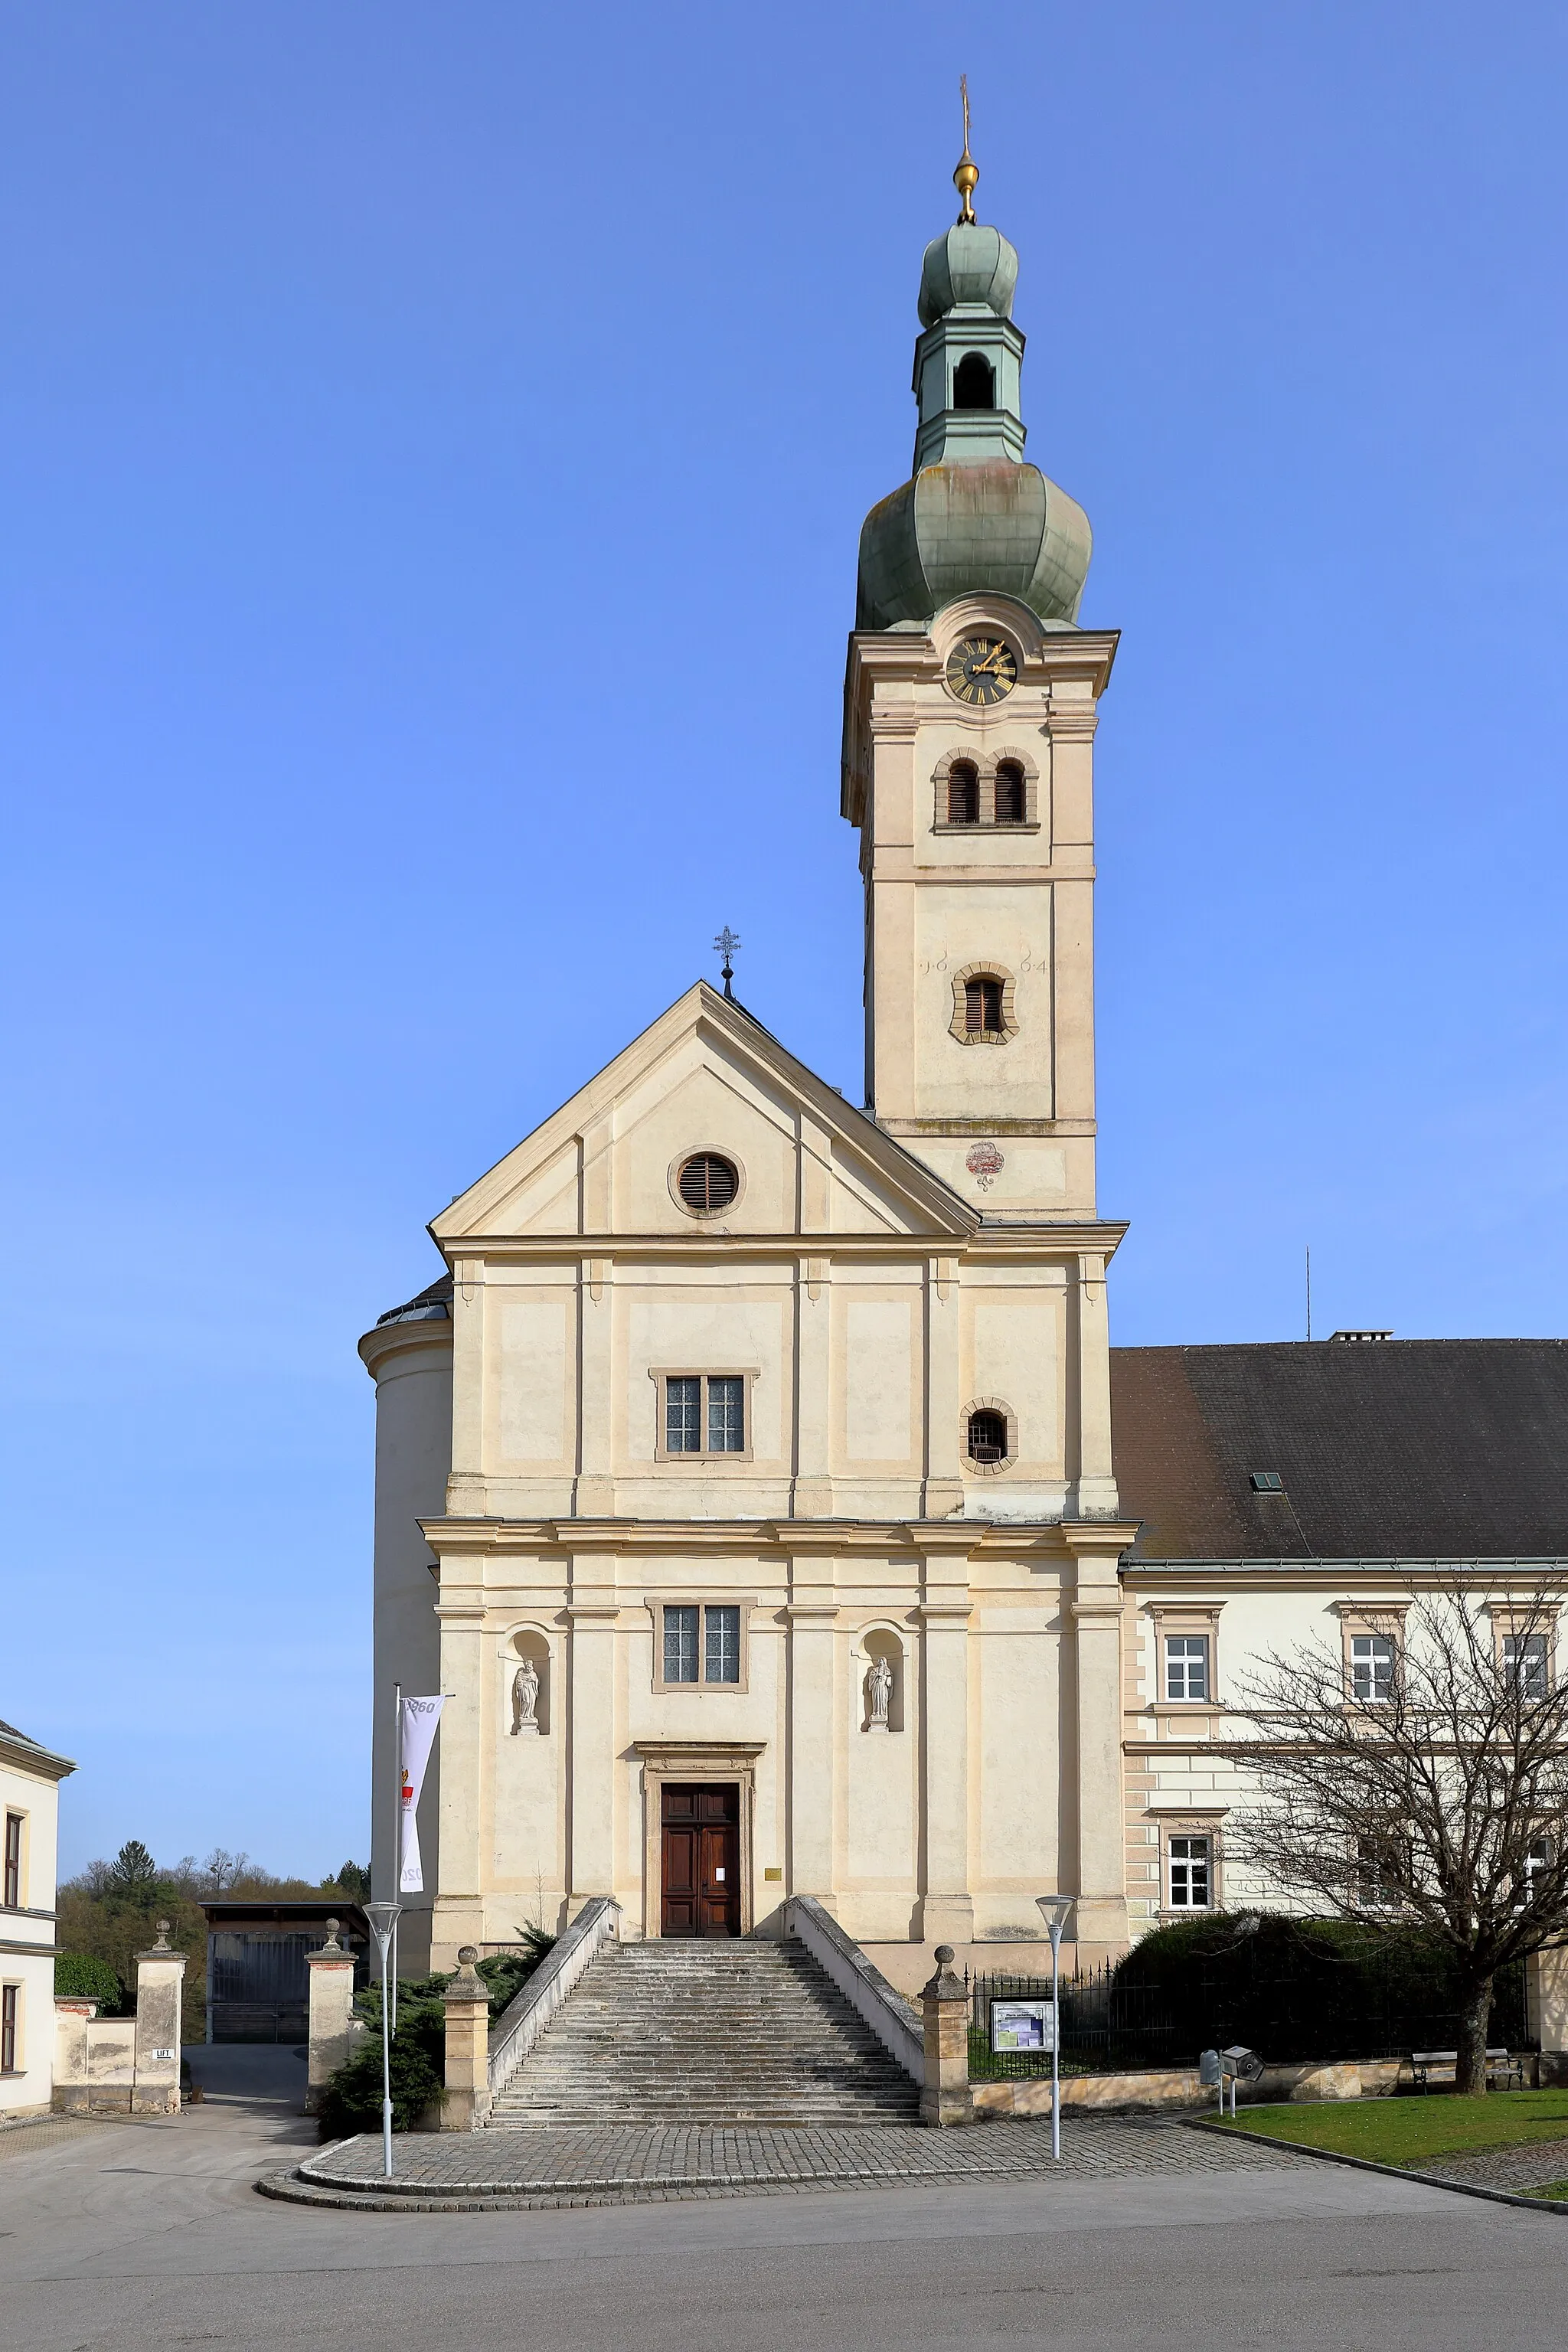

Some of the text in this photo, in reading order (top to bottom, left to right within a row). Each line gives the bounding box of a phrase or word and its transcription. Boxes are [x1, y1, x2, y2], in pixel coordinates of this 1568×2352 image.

[962, 641, 975, 658] XI
[977, 639, 988, 654] XII
[951, 652, 968, 664] X
